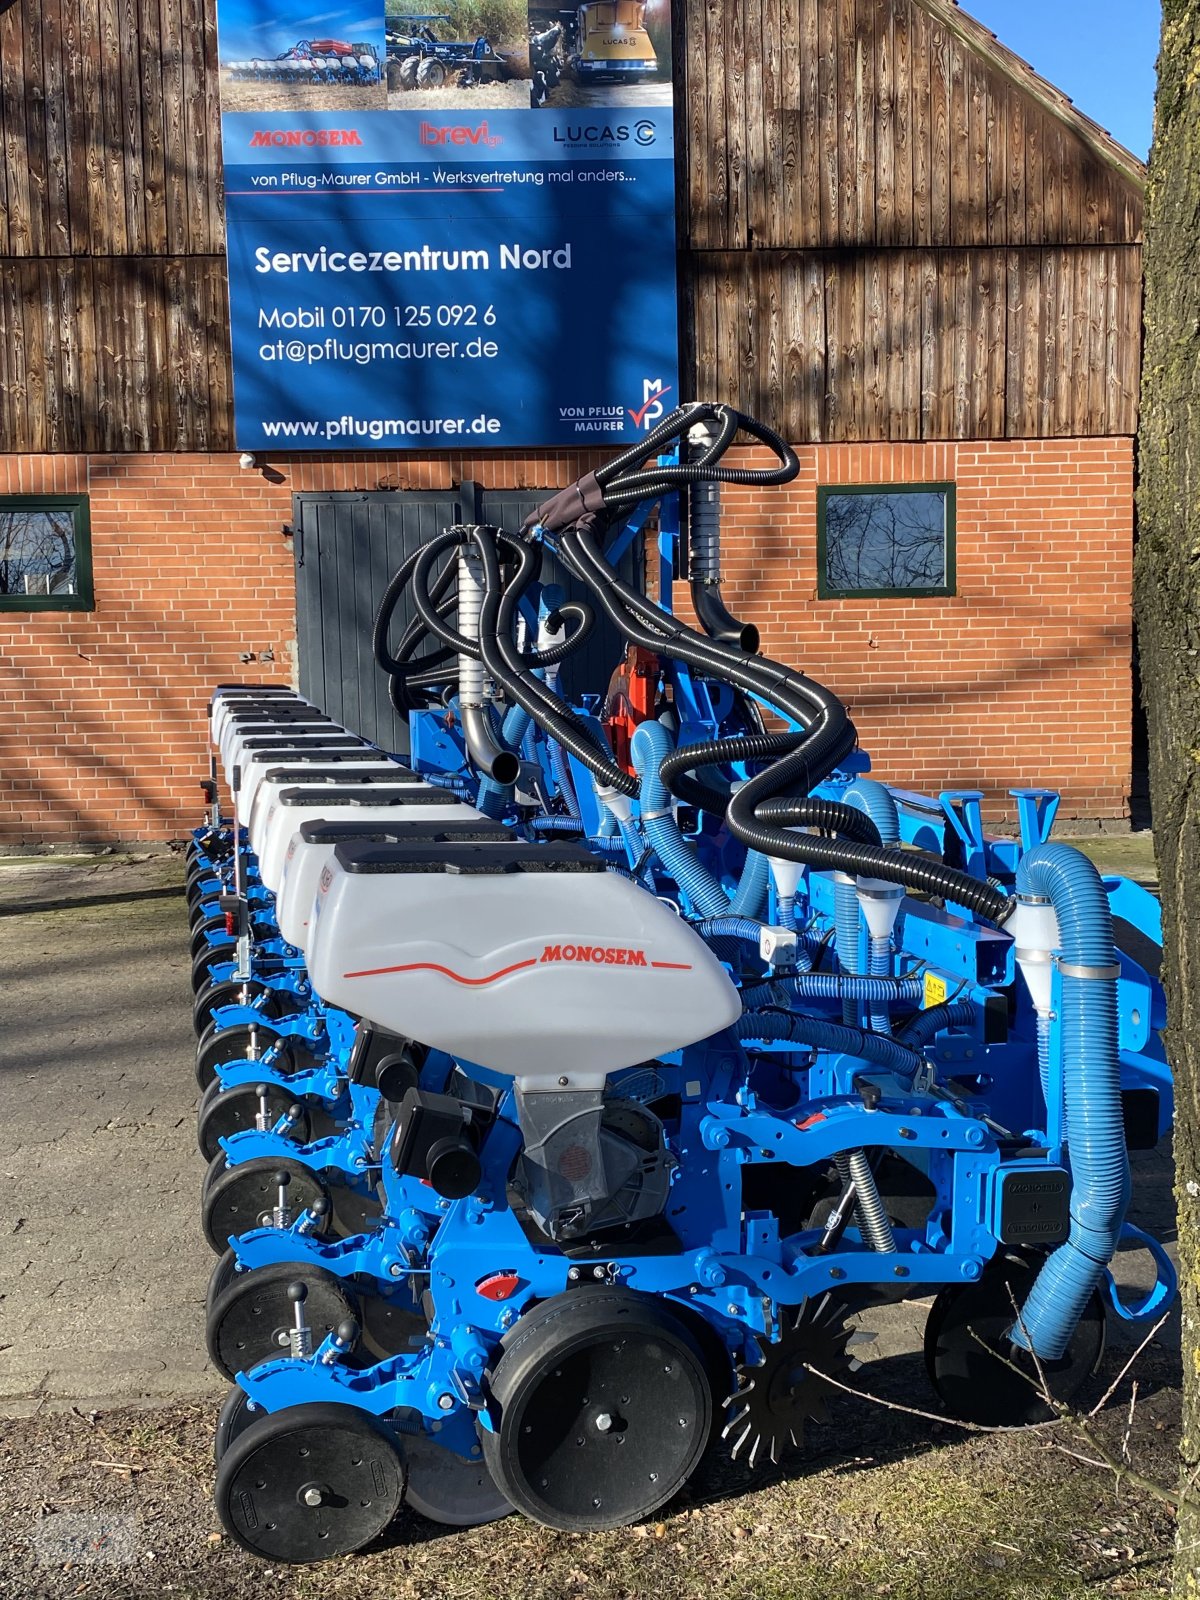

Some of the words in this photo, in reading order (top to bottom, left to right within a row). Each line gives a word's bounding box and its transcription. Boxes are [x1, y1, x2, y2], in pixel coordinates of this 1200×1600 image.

[250, 130, 362, 146] MONOSEM
[420, 120, 488, 145] brevi
[553, 126, 630, 142] LUCAS
[251, 176, 278, 186] von
[281, 172, 372, 188] Pflug-Maurer
[374, 172, 420, 185] GmbH
[433, 170, 544, 186] Werksvertretung
[548, 170, 574, 182] mal
[577, 169, 637, 182] anders...
[255, 245, 490, 273] Servicezentrum
[500, 243, 572, 270] Nord
[258, 306, 325, 329] Mobil
[331, 306, 386, 328] 0170
[394, 305, 432, 327] 125
[259, 337, 498, 365] at@pflugmaurer.de
[559, 407, 585, 417] VON
[588, 406, 624, 416] PFLUG
[262, 414, 501, 440] www.pflugmaurer.de
[574, 421, 625, 432] MAURER
[540, 945, 647, 967] MONOSEM
